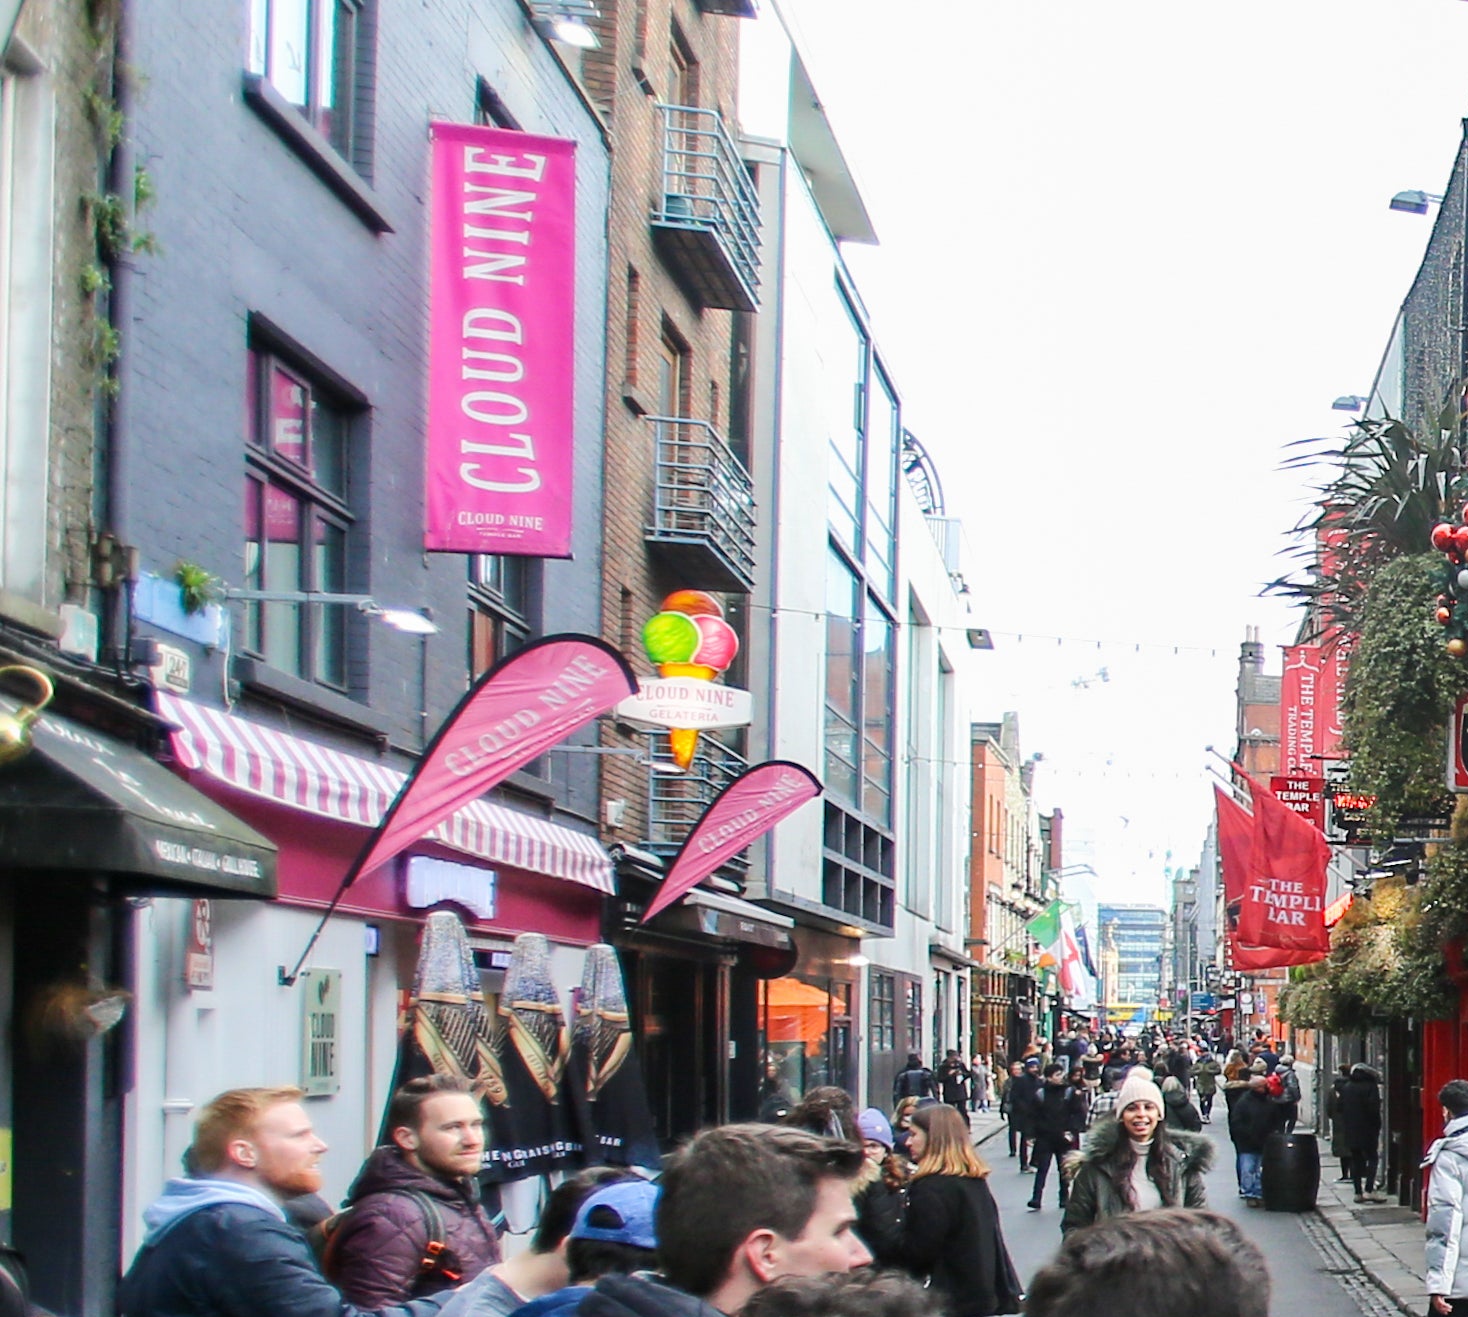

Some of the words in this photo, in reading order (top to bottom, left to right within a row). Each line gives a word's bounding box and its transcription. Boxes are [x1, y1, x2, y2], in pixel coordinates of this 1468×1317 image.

[463, 146, 547, 286] NINE
[460, 306, 543, 494] CLOUD
[458, 511, 505, 526] CLOUD
[509, 514, 543, 531] NINE
[636, 684, 689, 702] CLOUD
[696, 688, 735, 708] NINE
[1301, 673, 1315, 706] THE
[444, 708, 542, 777] CLOUD
[538, 654, 608, 711] NINE
[649, 708, 720, 723] GELATERIA
[1287, 705, 1298, 755] TRADING
[1300, 709, 1315, 774] TEMPLE
[1275, 791, 1320, 802] TEMPLE
[1287, 781, 1310, 791] THE
[698, 808, 761, 854] CLOUD
[757, 773, 806, 812] NINE
[1269, 878, 1304, 894] THE
